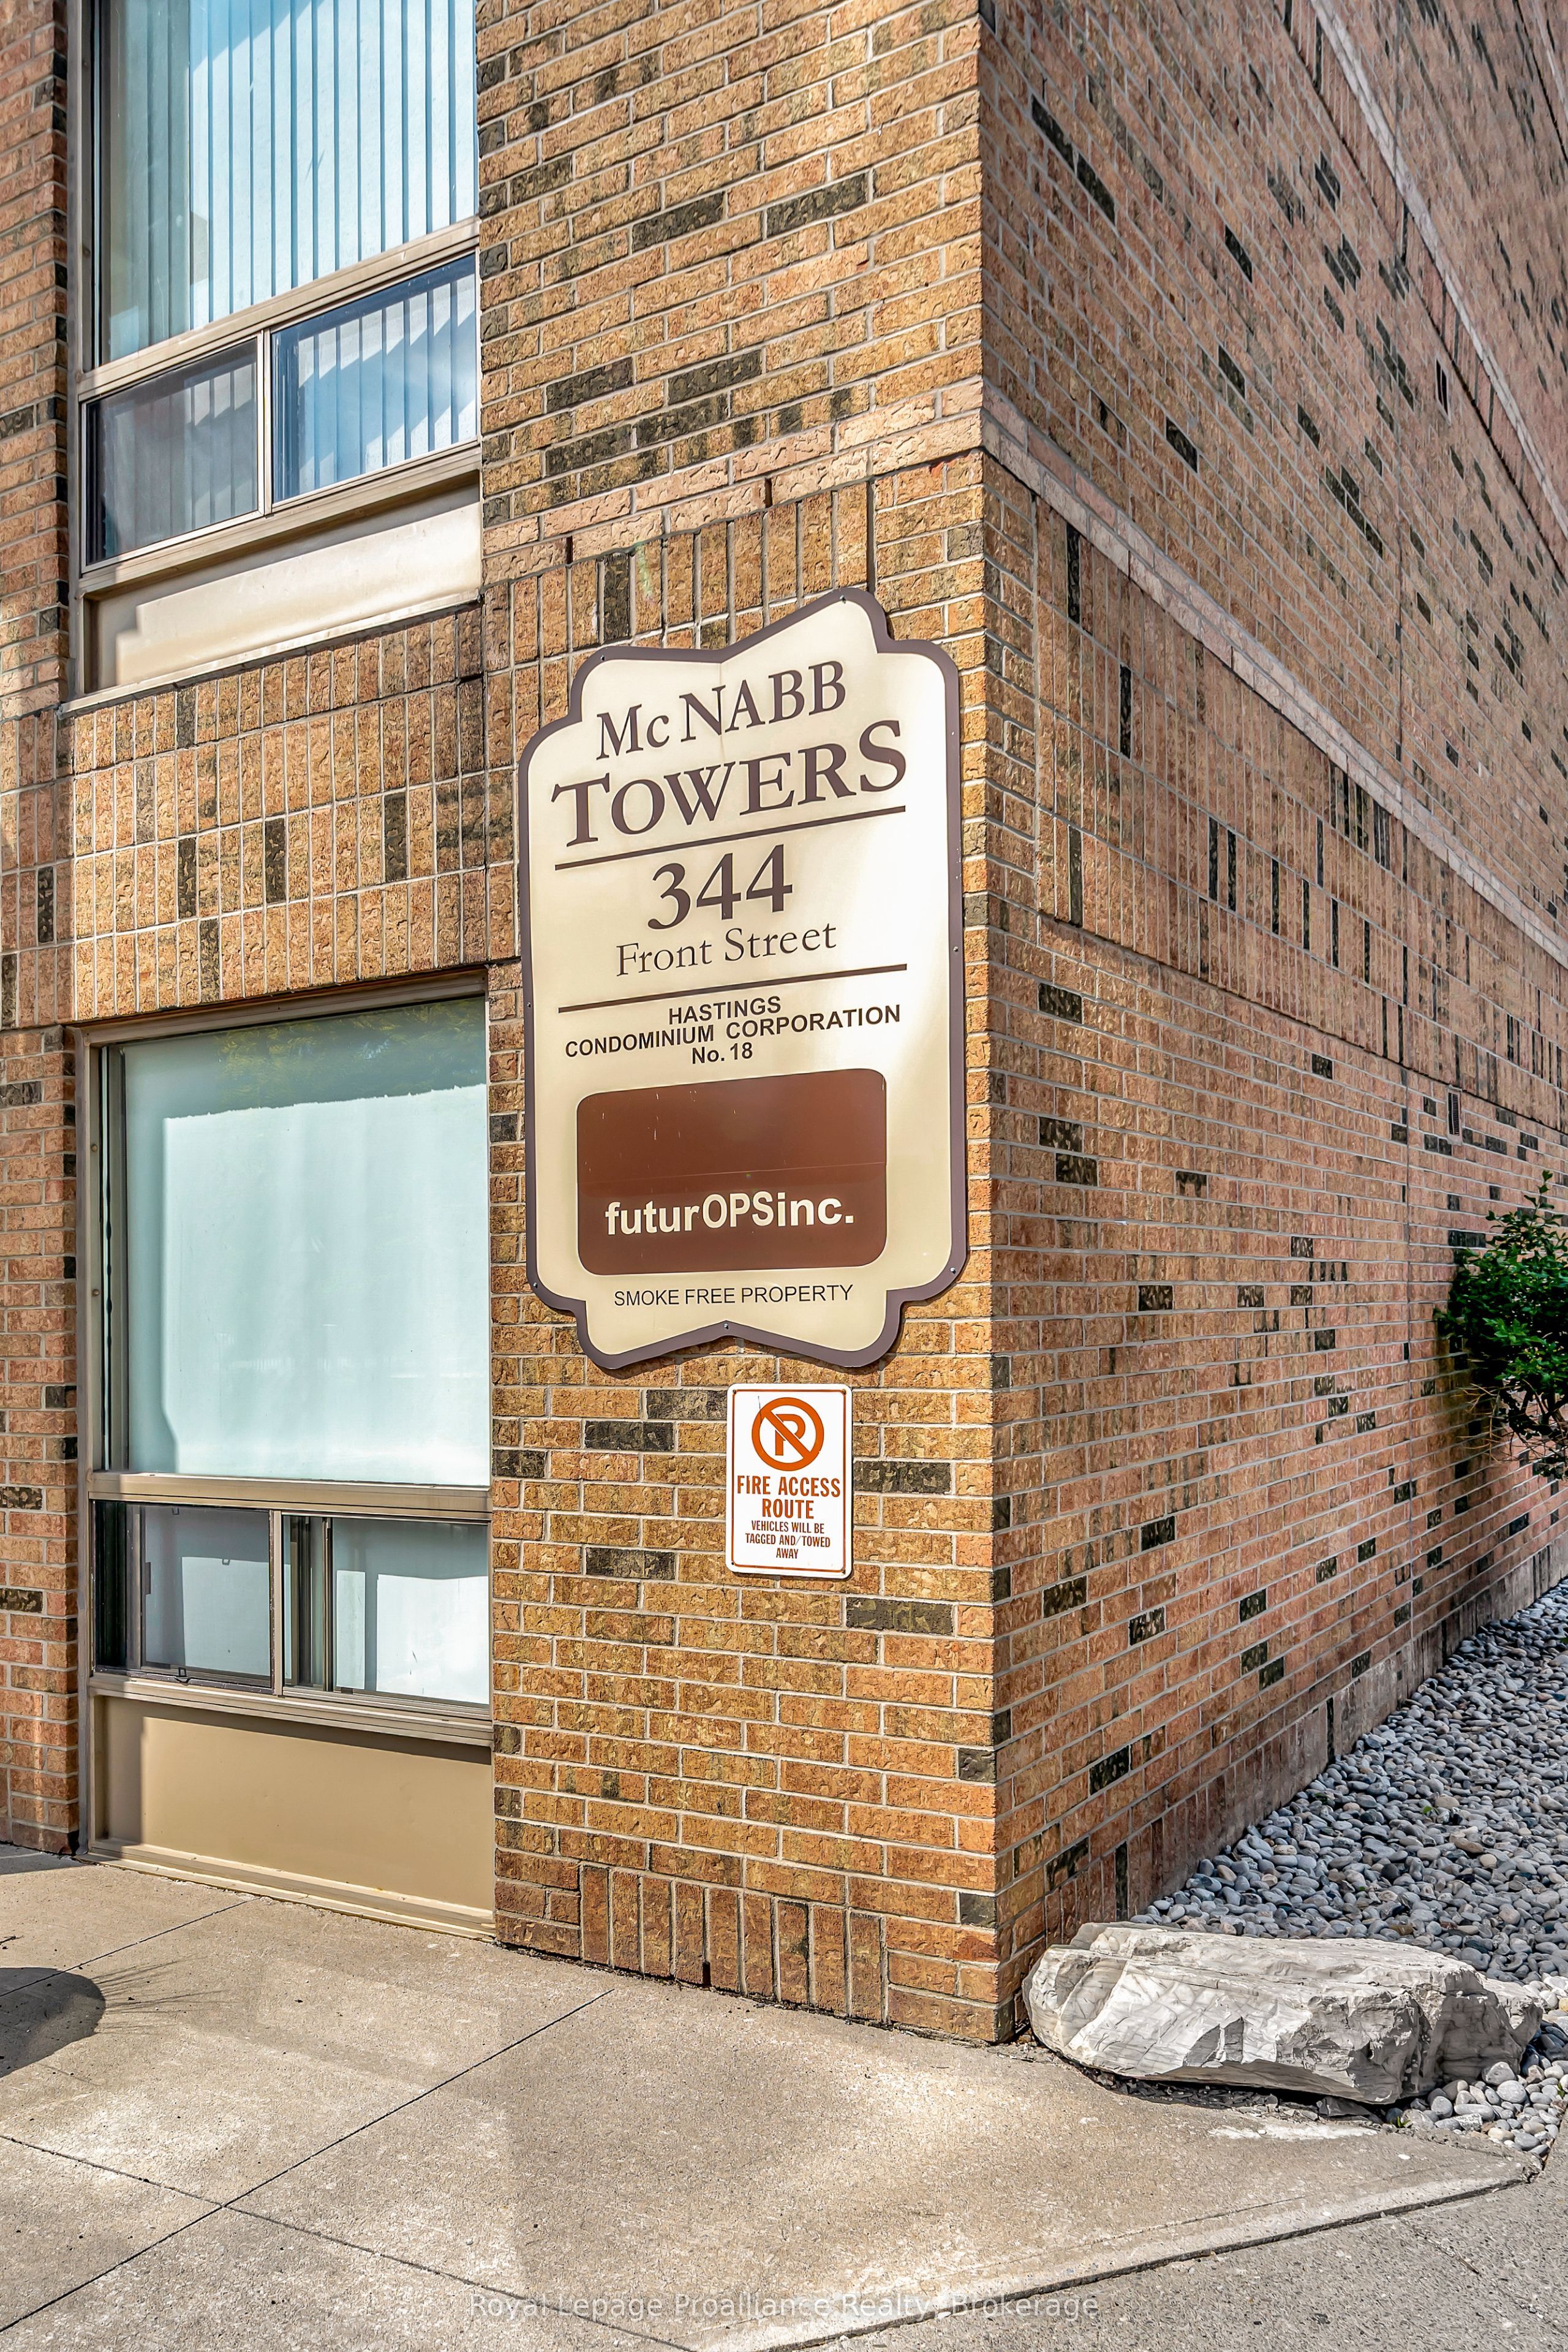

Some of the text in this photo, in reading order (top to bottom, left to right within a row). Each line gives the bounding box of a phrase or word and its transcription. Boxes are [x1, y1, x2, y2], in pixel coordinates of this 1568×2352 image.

[551, 720, 907, 848] TOWERS
[647, 844, 793, 930] 344
[616, 923, 837, 977] Front Street
[669, 995, 781, 1025] HASTINGS
[565, 1004, 900, 1058] CONDOMINIUM CORPORATION
[692, 1042, 753, 1065] No. 18
[605, 1191, 854, 1235] futurOPSinc.
[614, 1284, 854, 1306] SMOKE FREE PROPERTY
[737, 1475, 840, 1498] FIRE ACCESS
[762, 1498, 814, 1520] ROUTE
[745, 1532, 776, 1545] TAGGED
[751, 1520, 825, 1534] VEHICLES WILL BE
[775, 1547, 799, 1559] AWAY
